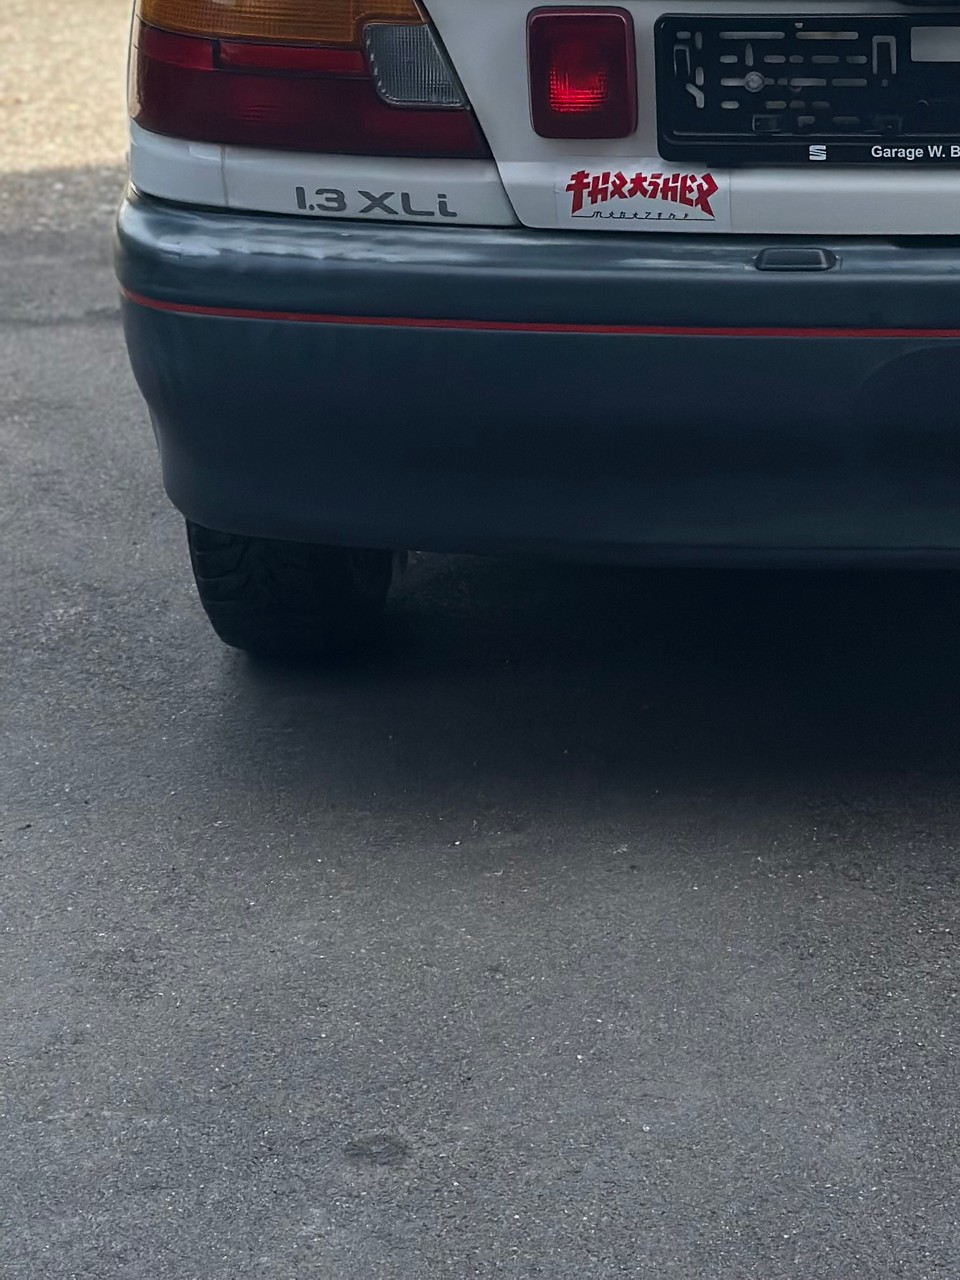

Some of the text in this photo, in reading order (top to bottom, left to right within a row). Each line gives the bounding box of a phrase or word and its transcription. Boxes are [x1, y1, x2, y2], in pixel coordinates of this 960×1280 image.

[871, 145, 924, 160] Garage
[927, 145, 946, 158] W.
[295, 186, 458, 218] 1.3 XLi
[565, 170, 719, 218] THRASHER
